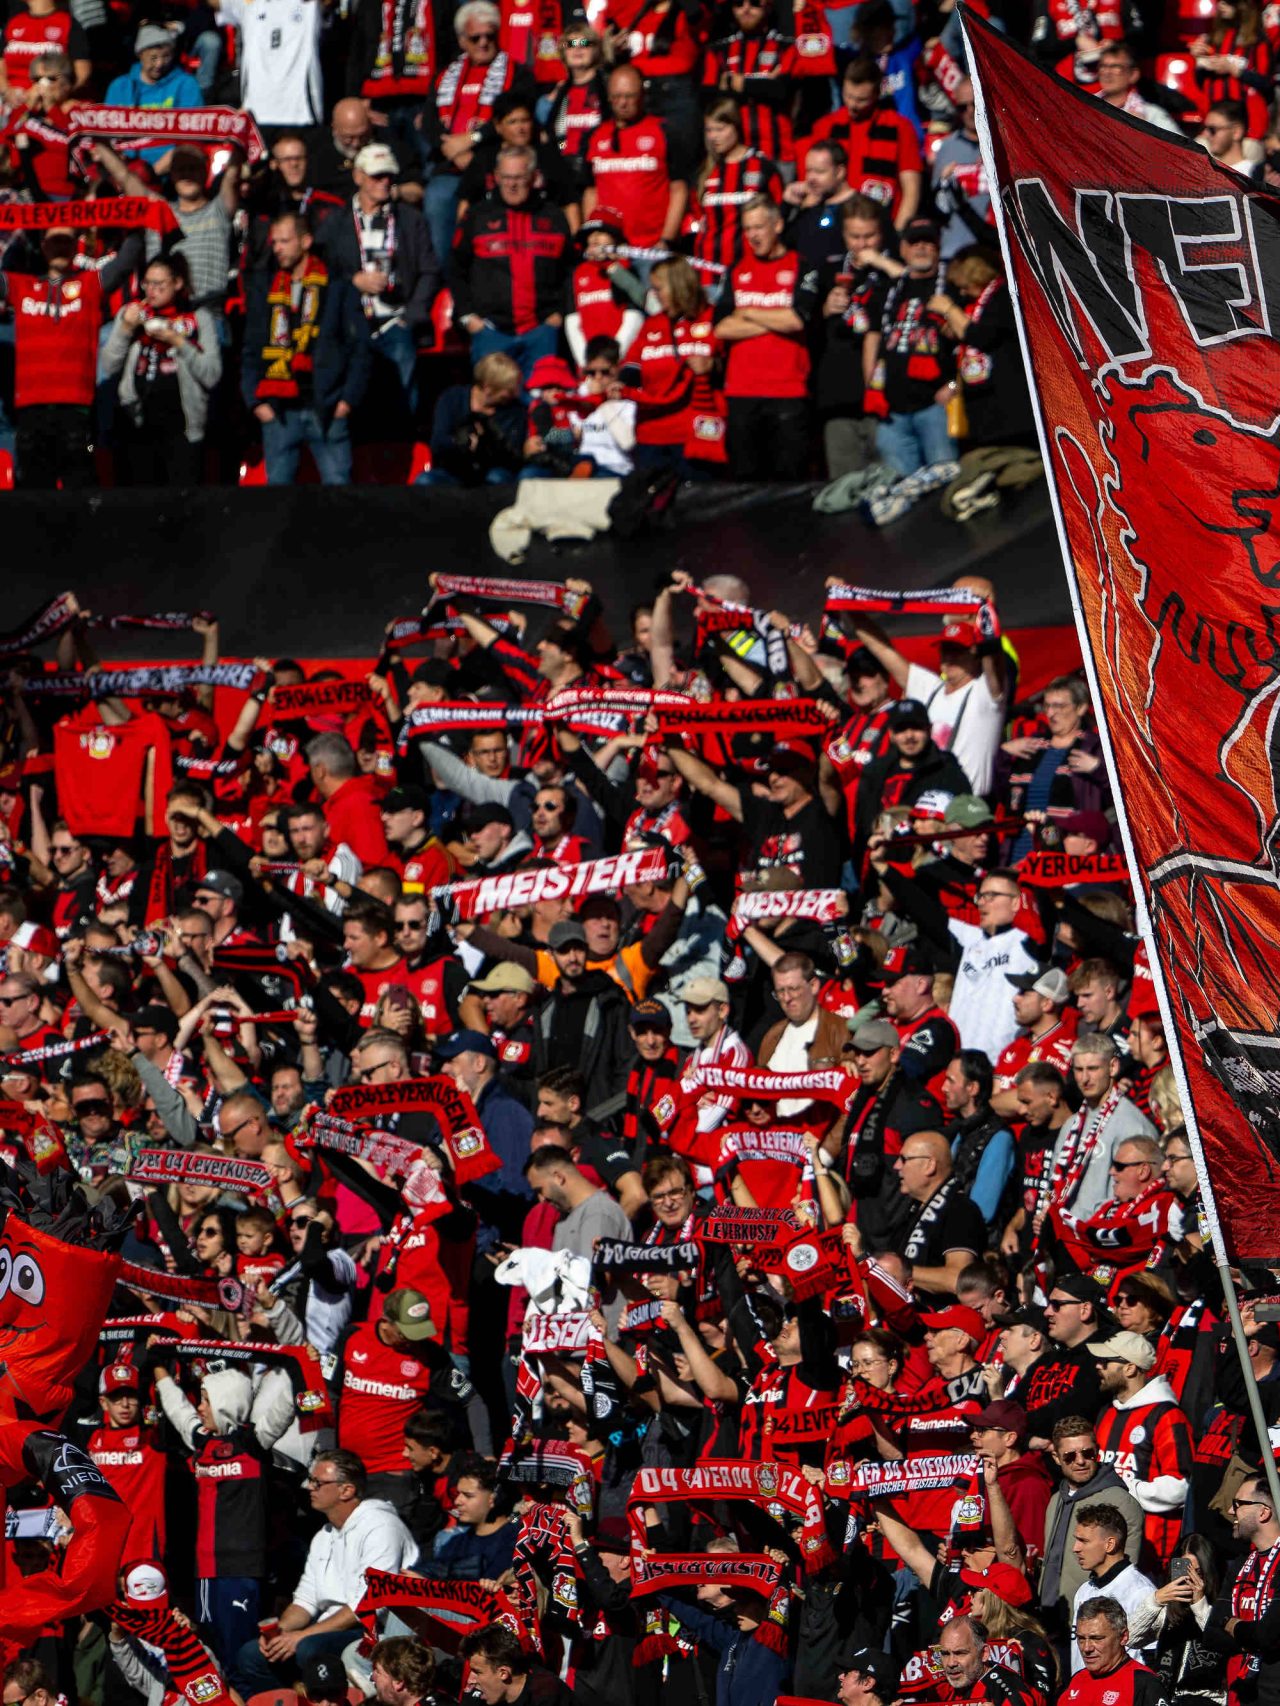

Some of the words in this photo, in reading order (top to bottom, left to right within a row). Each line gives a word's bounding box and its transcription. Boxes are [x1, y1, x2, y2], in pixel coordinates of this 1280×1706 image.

[21, 201, 148, 223] LEVERKUSEN
[1070, 855, 1093, 875] 04
[474, 849, 645, 910] MEISTER
[738, 888, 839, 919] MEISTER
[163, 1154, 184, 1172] 04
[186, 1155, 271, 1185] Leverkusen
[343, 1373, 418, 1399] Barmenia
[641, 1468, 679, 1493] 04
[882, 1459, 902, 1478] 04
[907, 1474, 938, 1490] MEISTER
